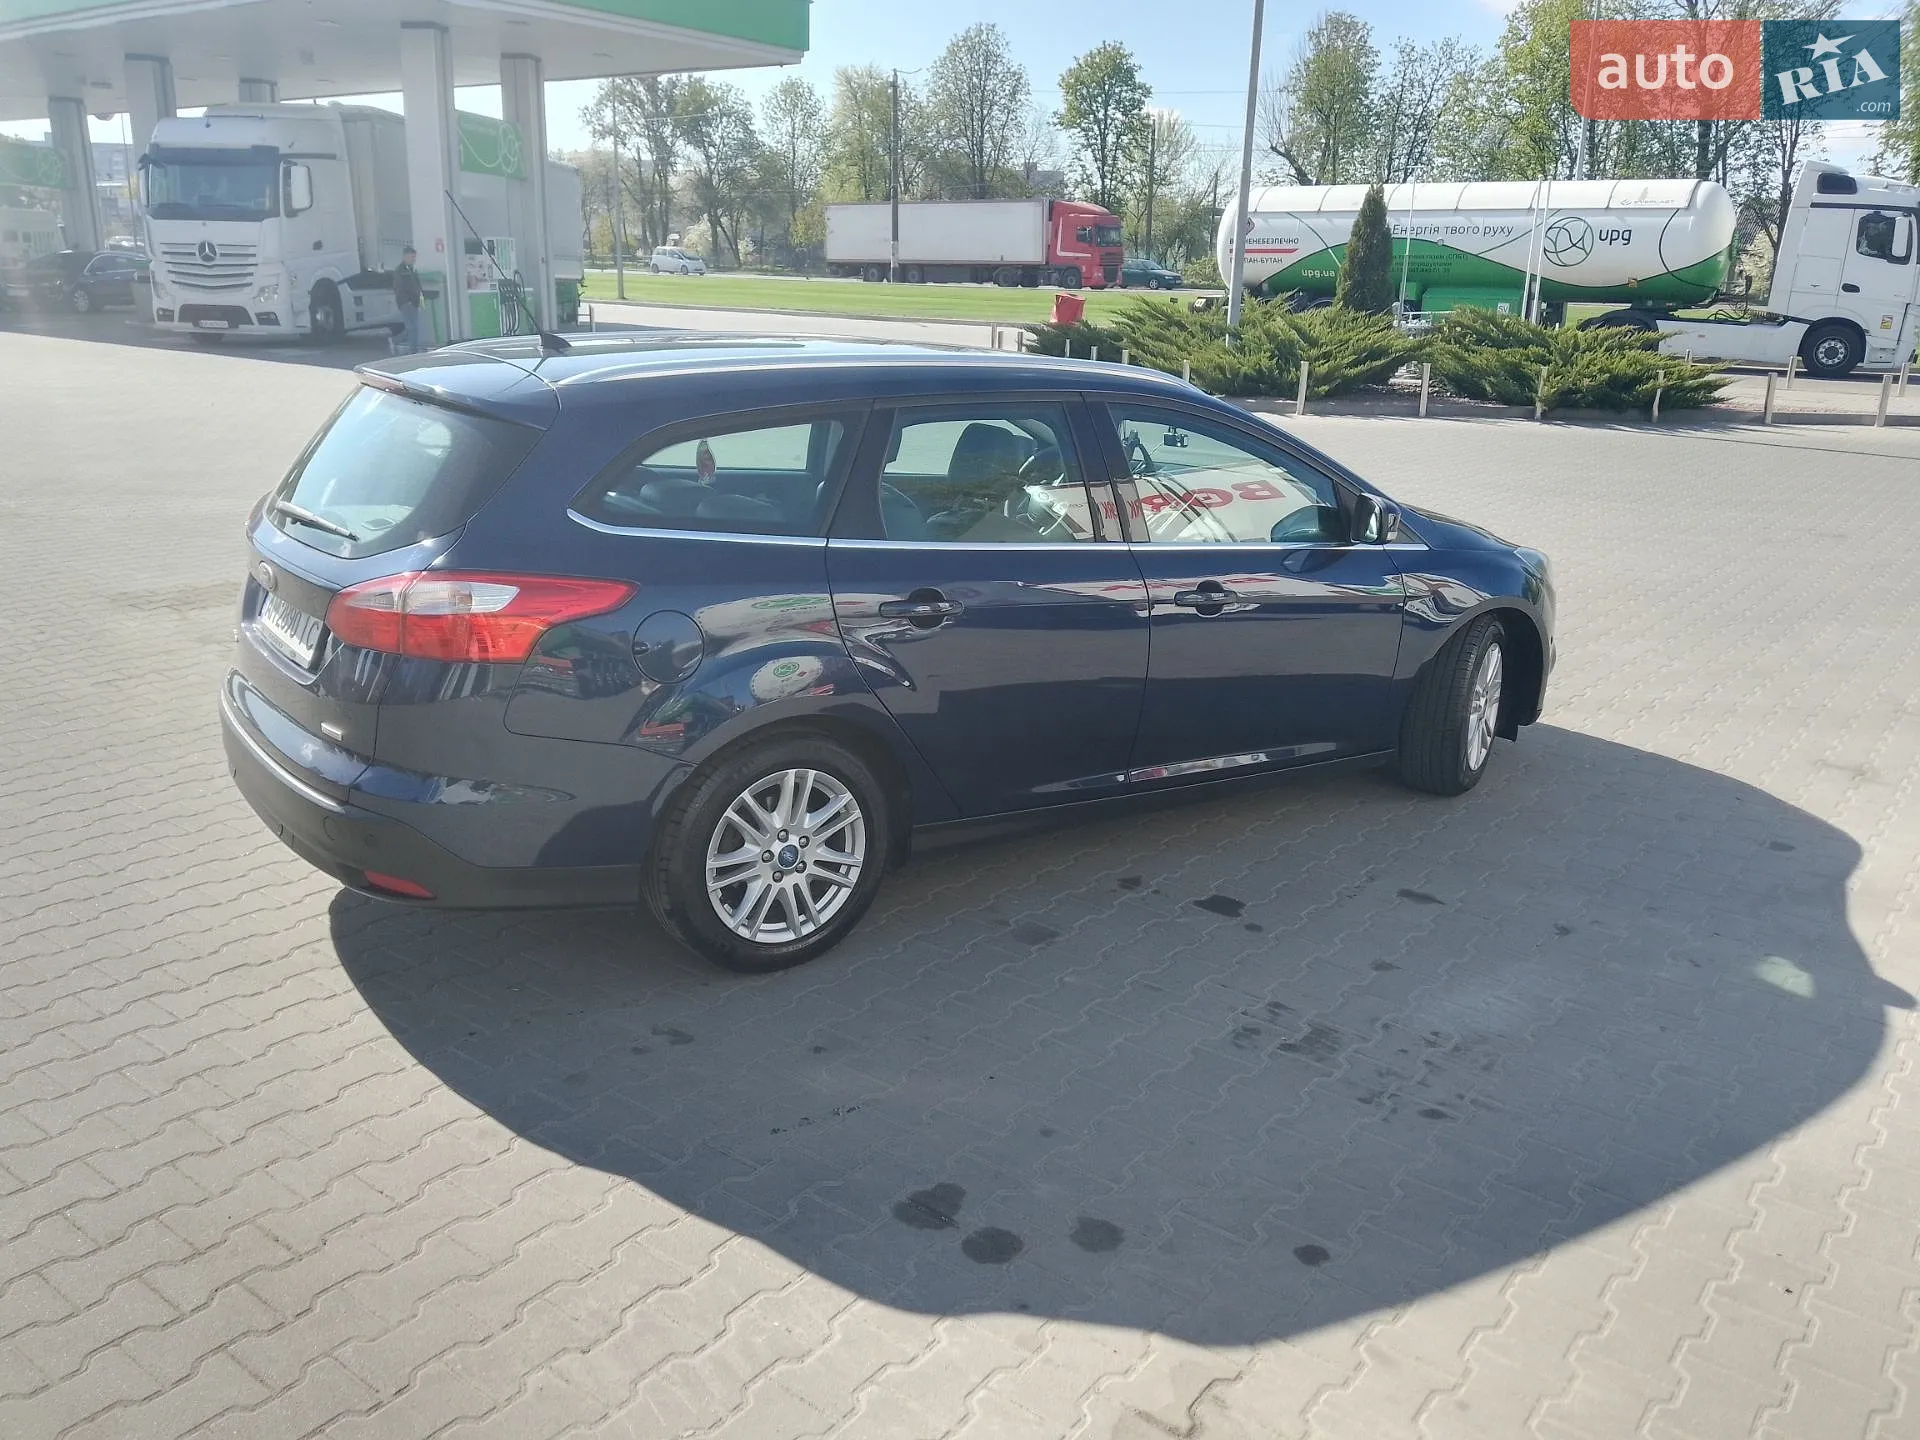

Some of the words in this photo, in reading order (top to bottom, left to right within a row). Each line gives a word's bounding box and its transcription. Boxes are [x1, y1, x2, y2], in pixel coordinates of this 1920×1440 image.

[1392, 223, 1440, 237] Енергія
[1444, 225, 1480, 235] твого
[1484, 225, 1514, 237] руху
[1599, 229, 1632, 246] upg
[1302, 270, 1336, 278] upg.ua
